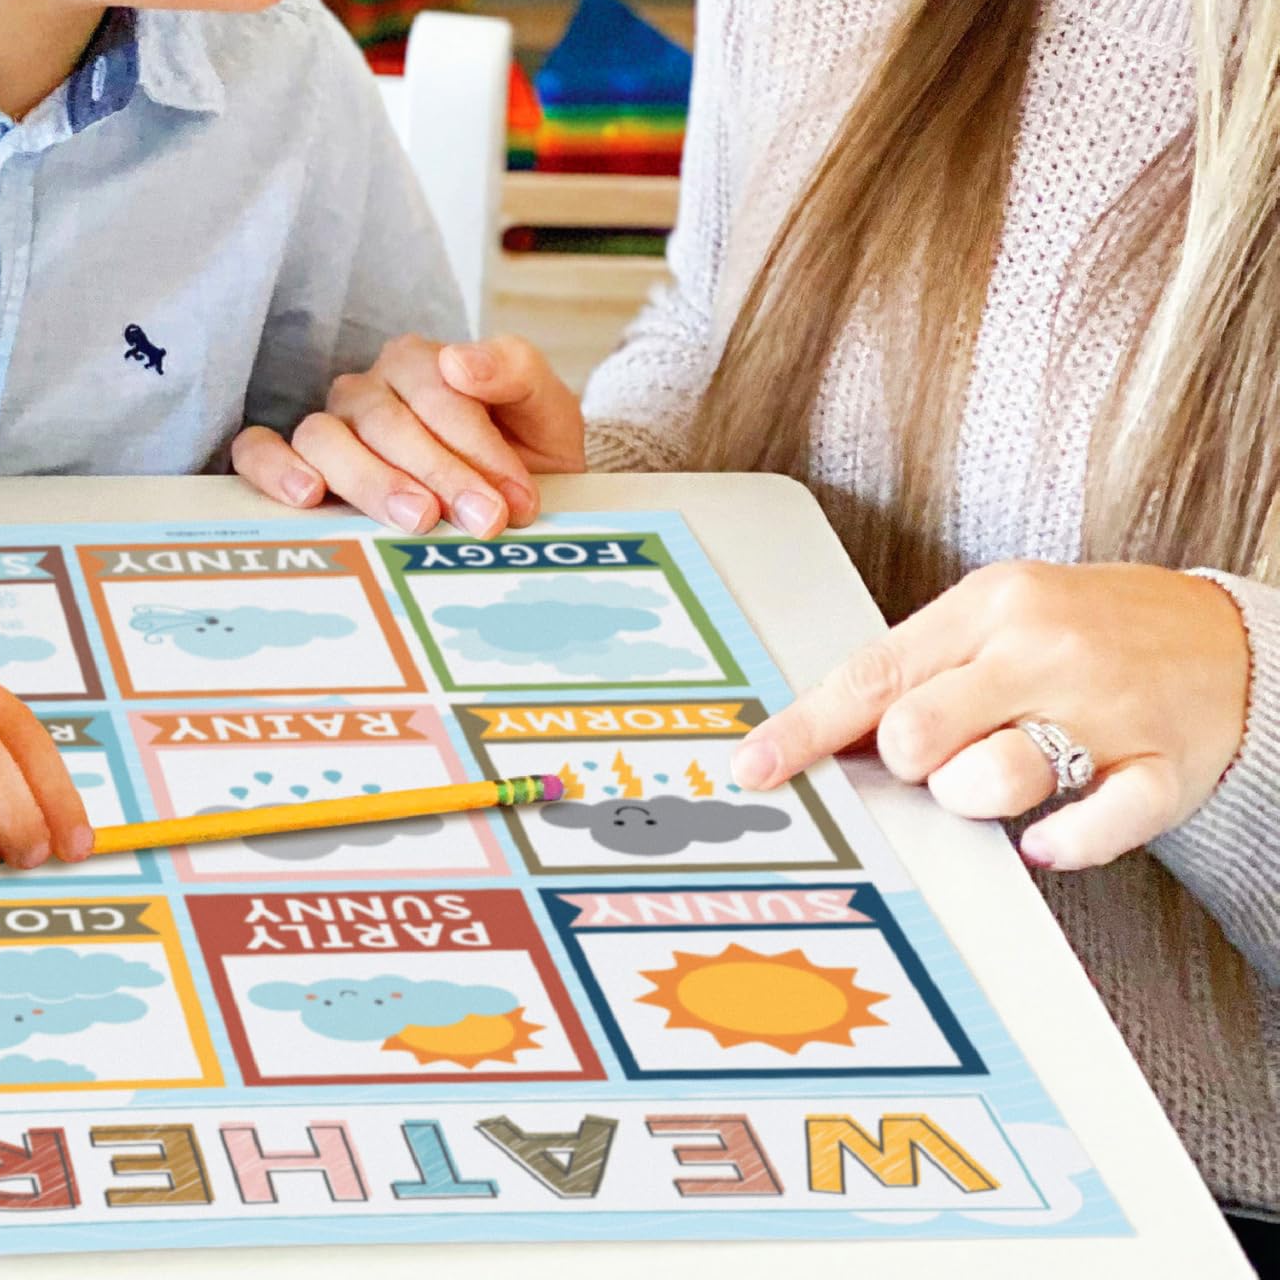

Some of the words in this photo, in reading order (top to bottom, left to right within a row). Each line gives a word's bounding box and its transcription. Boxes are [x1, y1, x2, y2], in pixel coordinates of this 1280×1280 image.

[111, 548, 328, 574] WINDY
[420, 542, 629, 568] FOGGY
[169, 711, 400, 742] RAINY
[493, 707, 741, 734] STORMY
[244, 893, 473, 923] SUNNY
[586, 889, 849, 923] SUNNY
[246, 921, 492, 950] PARTLY
